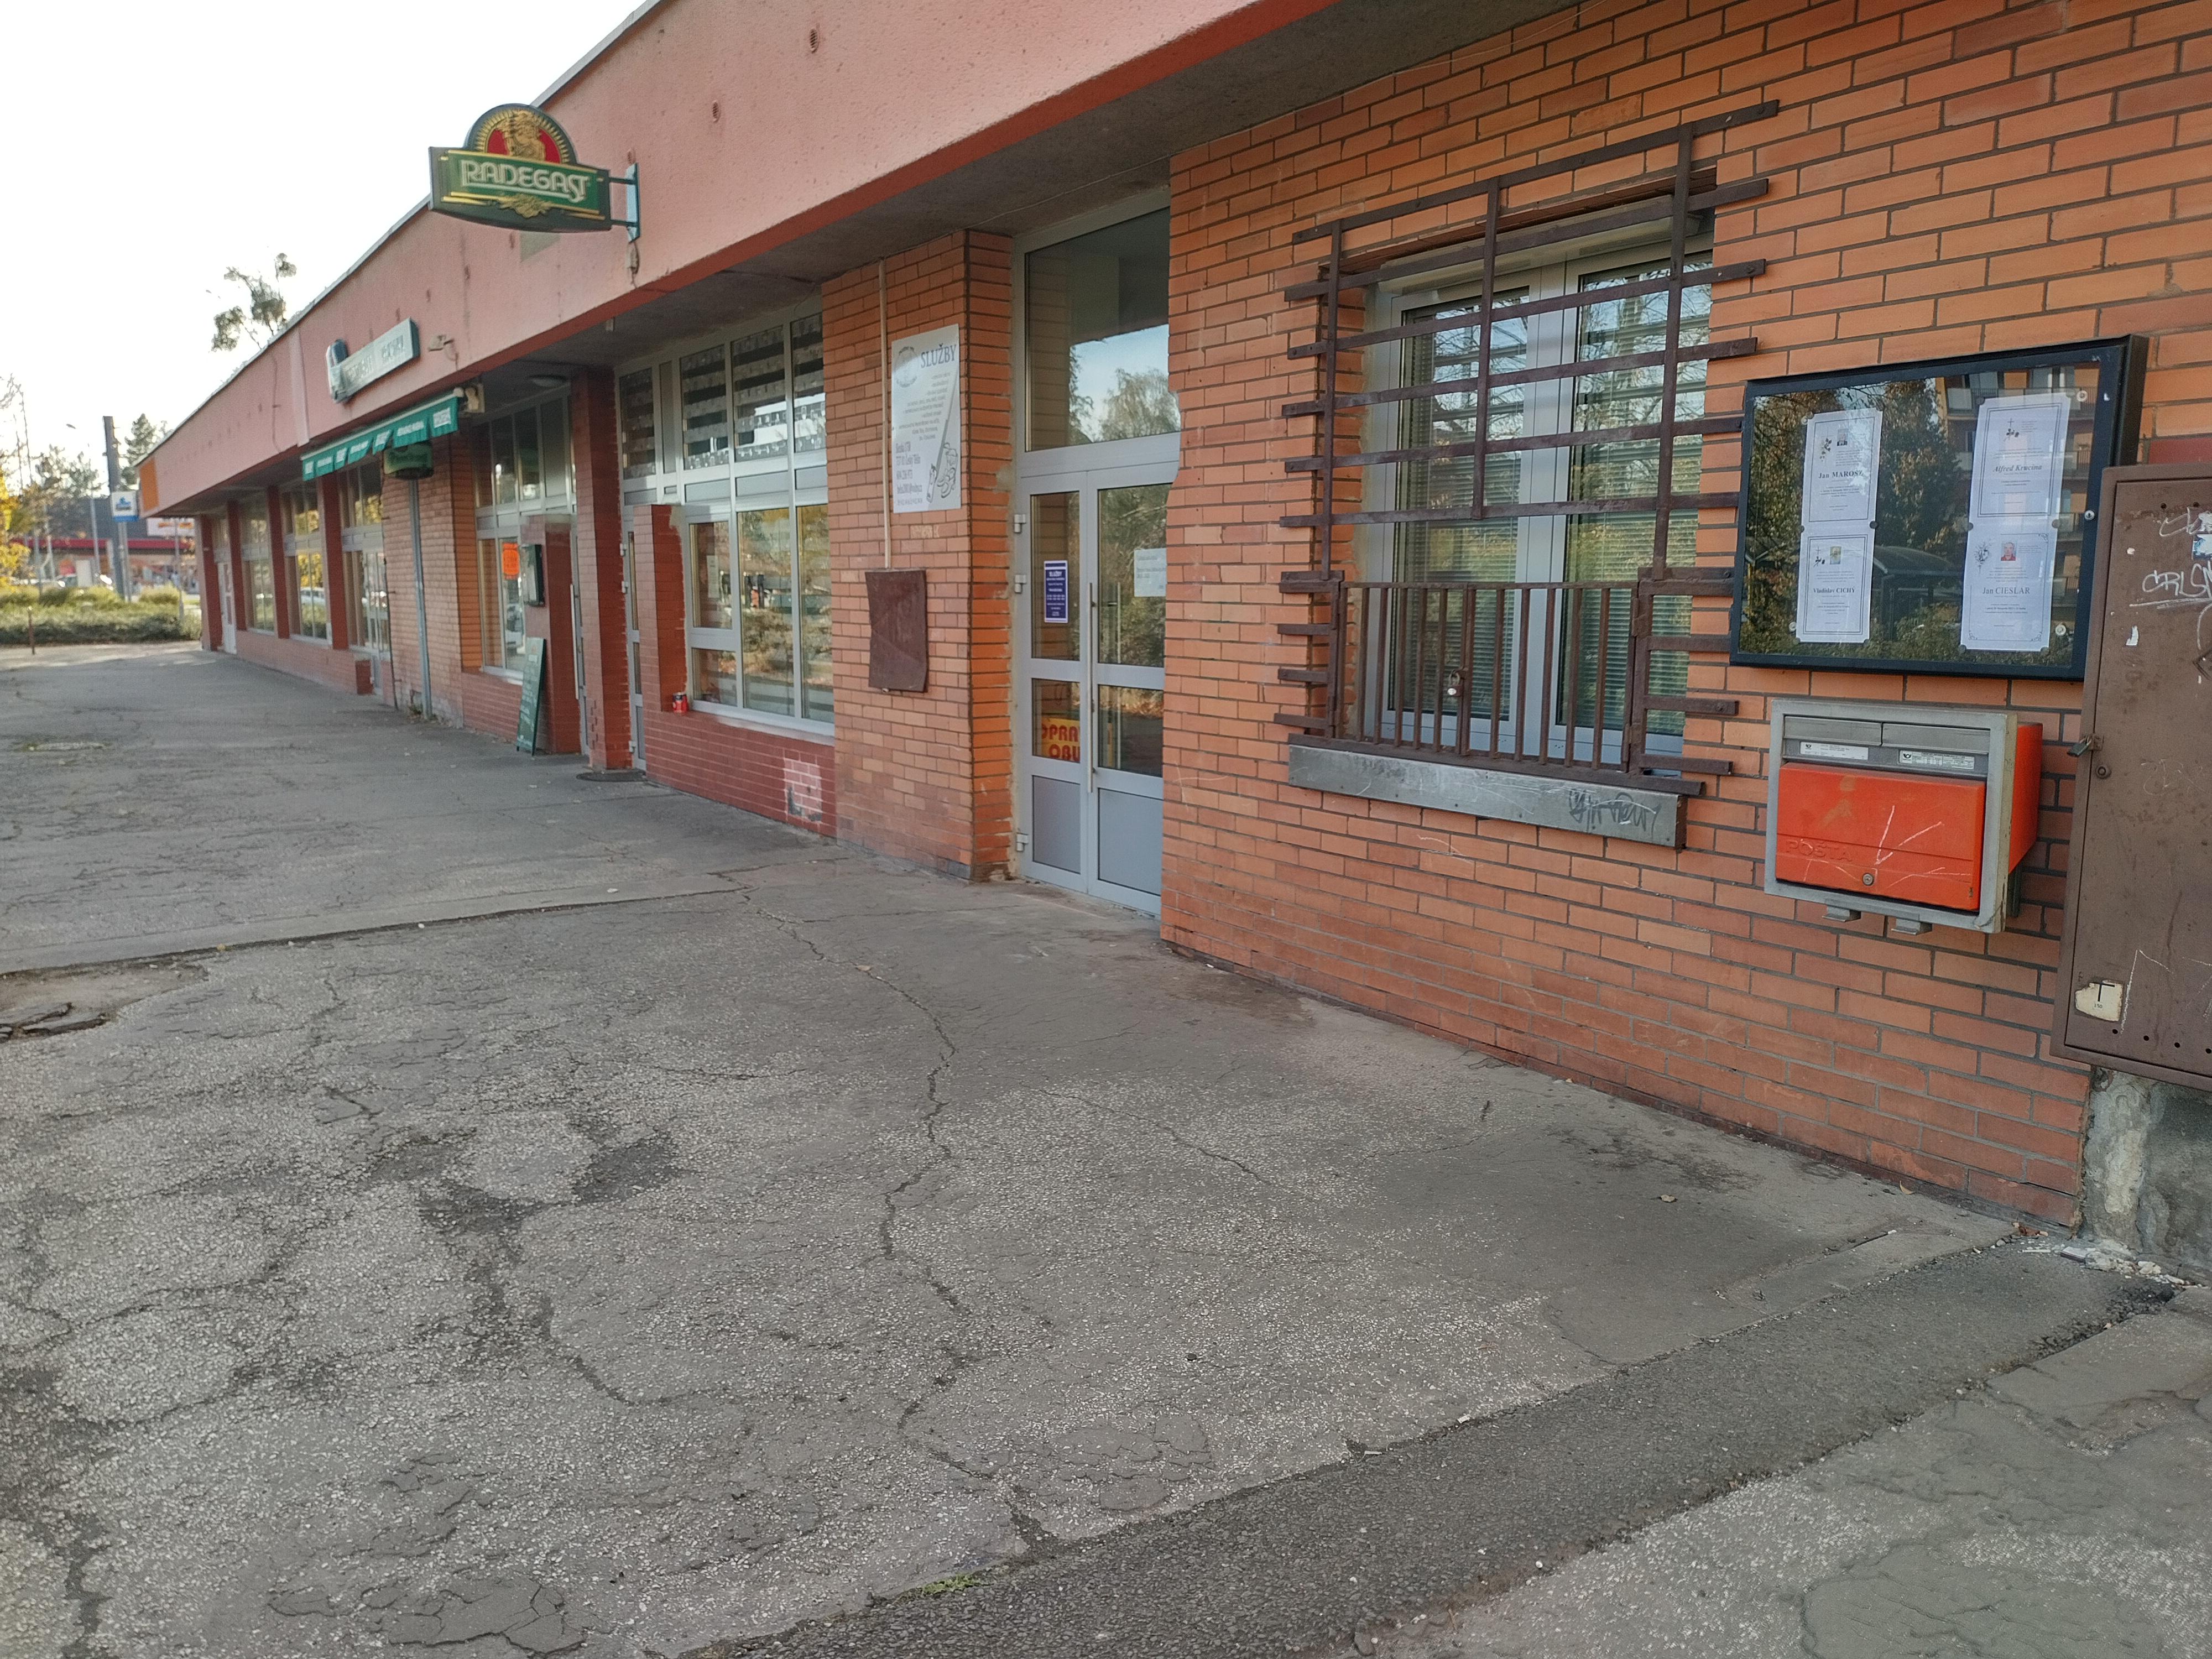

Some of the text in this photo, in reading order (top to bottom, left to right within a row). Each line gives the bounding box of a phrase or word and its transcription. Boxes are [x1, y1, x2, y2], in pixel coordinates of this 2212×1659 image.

[460, 159, 591, 204] RADEGAST
[920, 342, 957, 368] SLUŽBY
[1832, 469, 1864, 478] MAROSZ
[1992, 465, 2014, 473] Alfred
[1785, 839, 1853, 862] POŠTA
